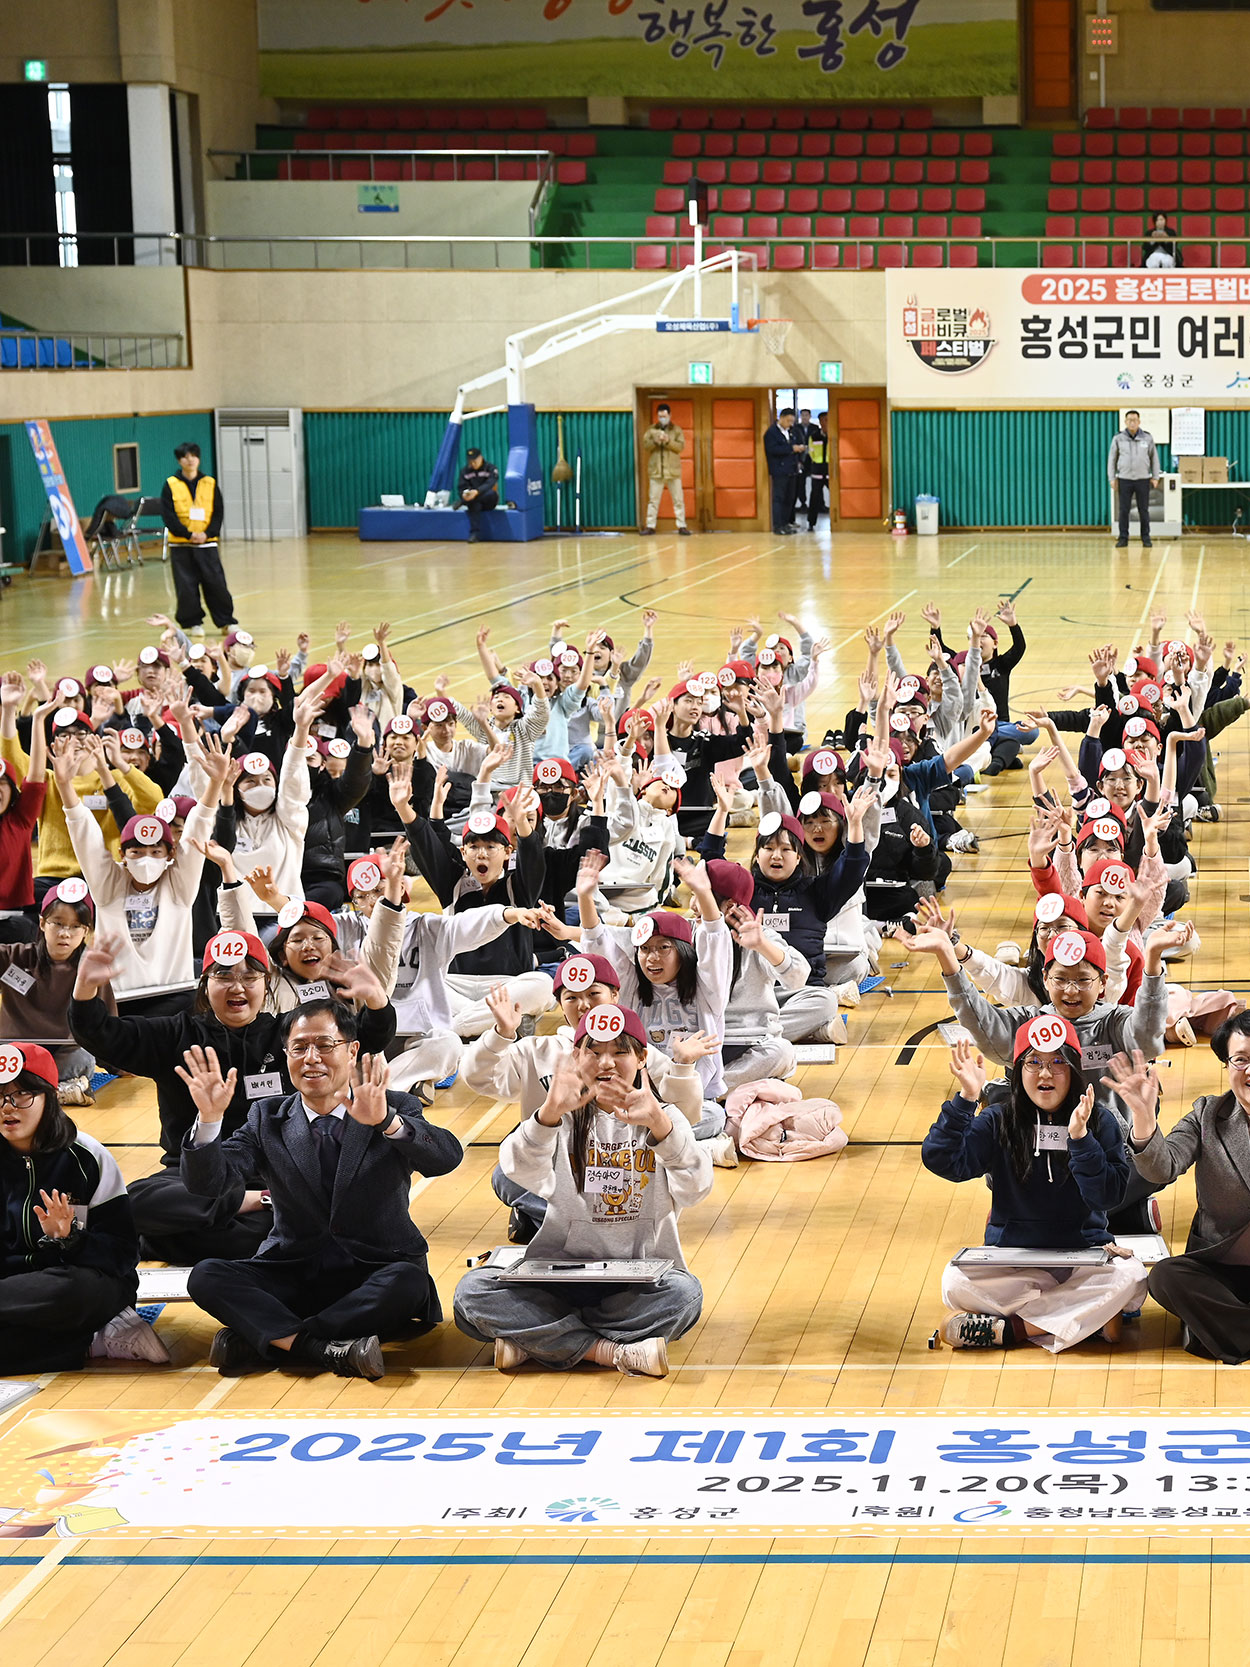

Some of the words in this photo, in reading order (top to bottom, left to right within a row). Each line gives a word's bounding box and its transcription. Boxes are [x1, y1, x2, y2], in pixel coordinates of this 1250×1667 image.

[638, 2, 776, 69] 행복한
[797, 0, 920, 72] 홍성
[1041, 279, 1107, 301] 2025
[921, 308, 967, 322] 글로벌
[921, 323, 967, 337] 바비큐
[1021, 315, 1161, 359] 홍성군민
[921, 341, 984, 357] 페스티벌
[700, 675, 716, 685] 122
[719, 672, 733, 682] 211
[430, 705, 447, 719] 105
[1123, 701, 1135, 711] 21
[393, 719, 411, 729] 133
[1127, 722, 1145, 733] 115
[123, 733, 142, 743] 184
[331, 743, 348, 753] 173
[248, 758, 265, 770] 72
[817, 756, 833, 769] 70
[542, 766, 557, 777] 86
[1090, 803, 1105, 813] 91
[474, 816, 491, 827] 93
[140, 825, 157, 838] 67
[1095, 823, 1118, 835] 109
[354, 865, 377, 888] 137
[59, 884, 86, 896] 141
[284, 906, 298, 920] 79
[1041, 901, 1058, 915] 27
[635, 923, 650, 942] 42
[213, 941, 244, 957] 142
[1054, 936, 1083, 962] 119
[567, 966, 589, 983] 95
[588, 1014, 621, 1033] 156
[1030, 1022, 1064, 1048] 190
[218, 1430, 604, 1466] 2025년
[628, 1428, 897, 1464] 제1회
[696, 1474, 1129, 1496] 2025.11.20(목)
